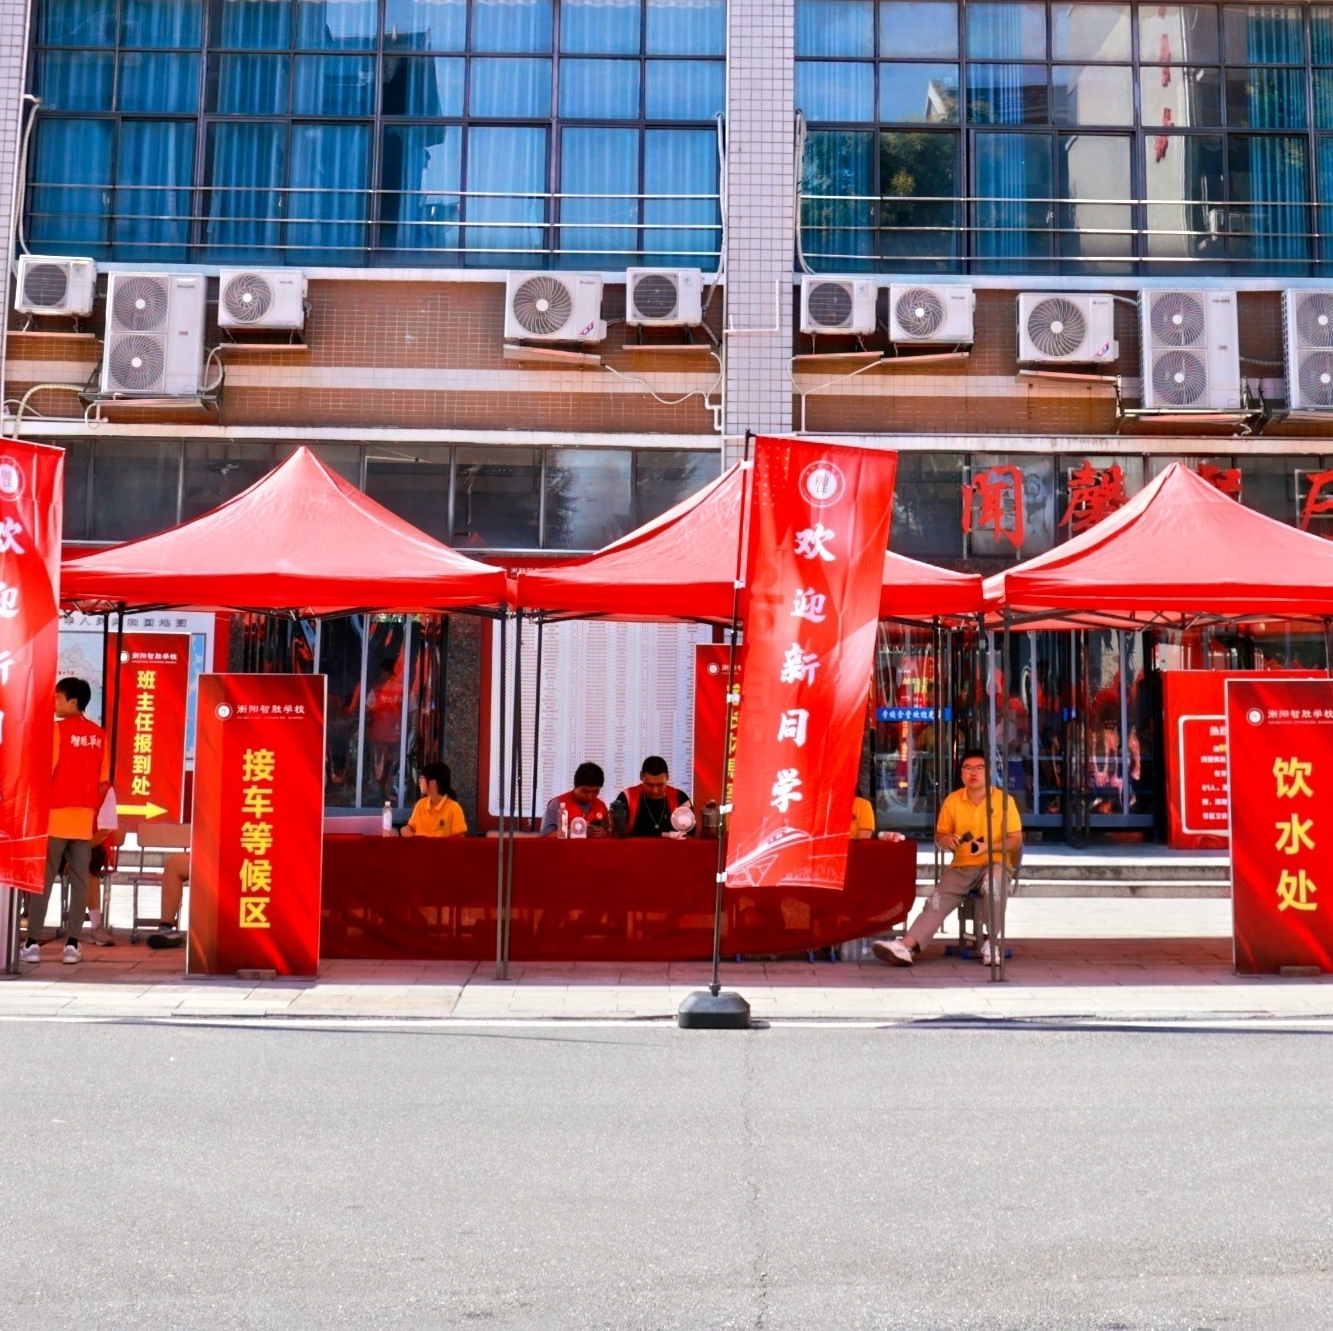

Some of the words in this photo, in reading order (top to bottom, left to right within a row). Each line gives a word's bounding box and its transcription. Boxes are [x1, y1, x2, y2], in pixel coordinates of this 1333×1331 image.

[131, 670, 156, 796] 班主任报到处
[770, 522, 837, 813] 欢迎新同学
[238, 748, 276, 930] 接车等候区
[1273, 757, 1318, 912] 饮水处
